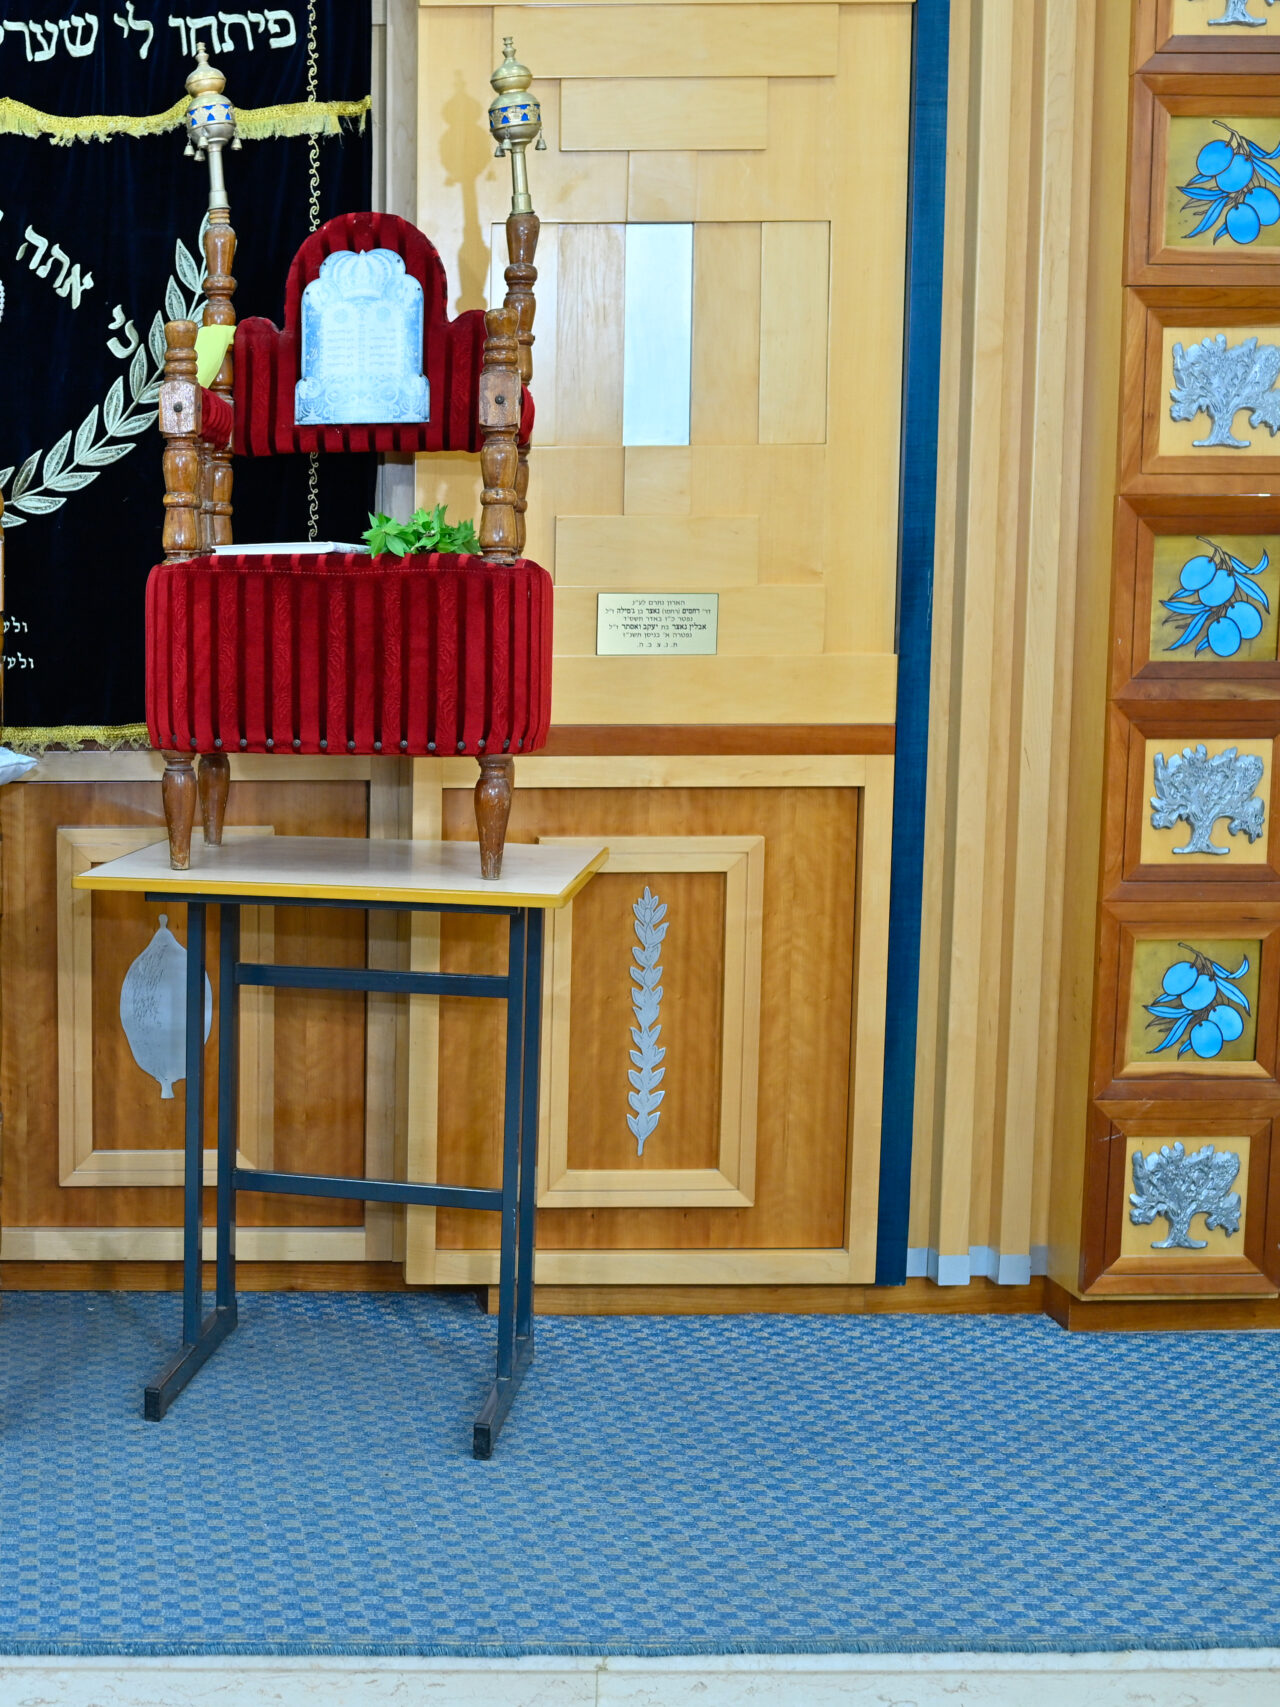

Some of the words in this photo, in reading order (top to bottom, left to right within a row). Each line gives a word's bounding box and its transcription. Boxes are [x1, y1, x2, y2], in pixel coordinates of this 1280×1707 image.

[114, 1, 153, 59] לי
[168, 9, 296, 57] פיתחו
[16, 225, 94, 309] אתה
[107, 305, 141, 359] כי
